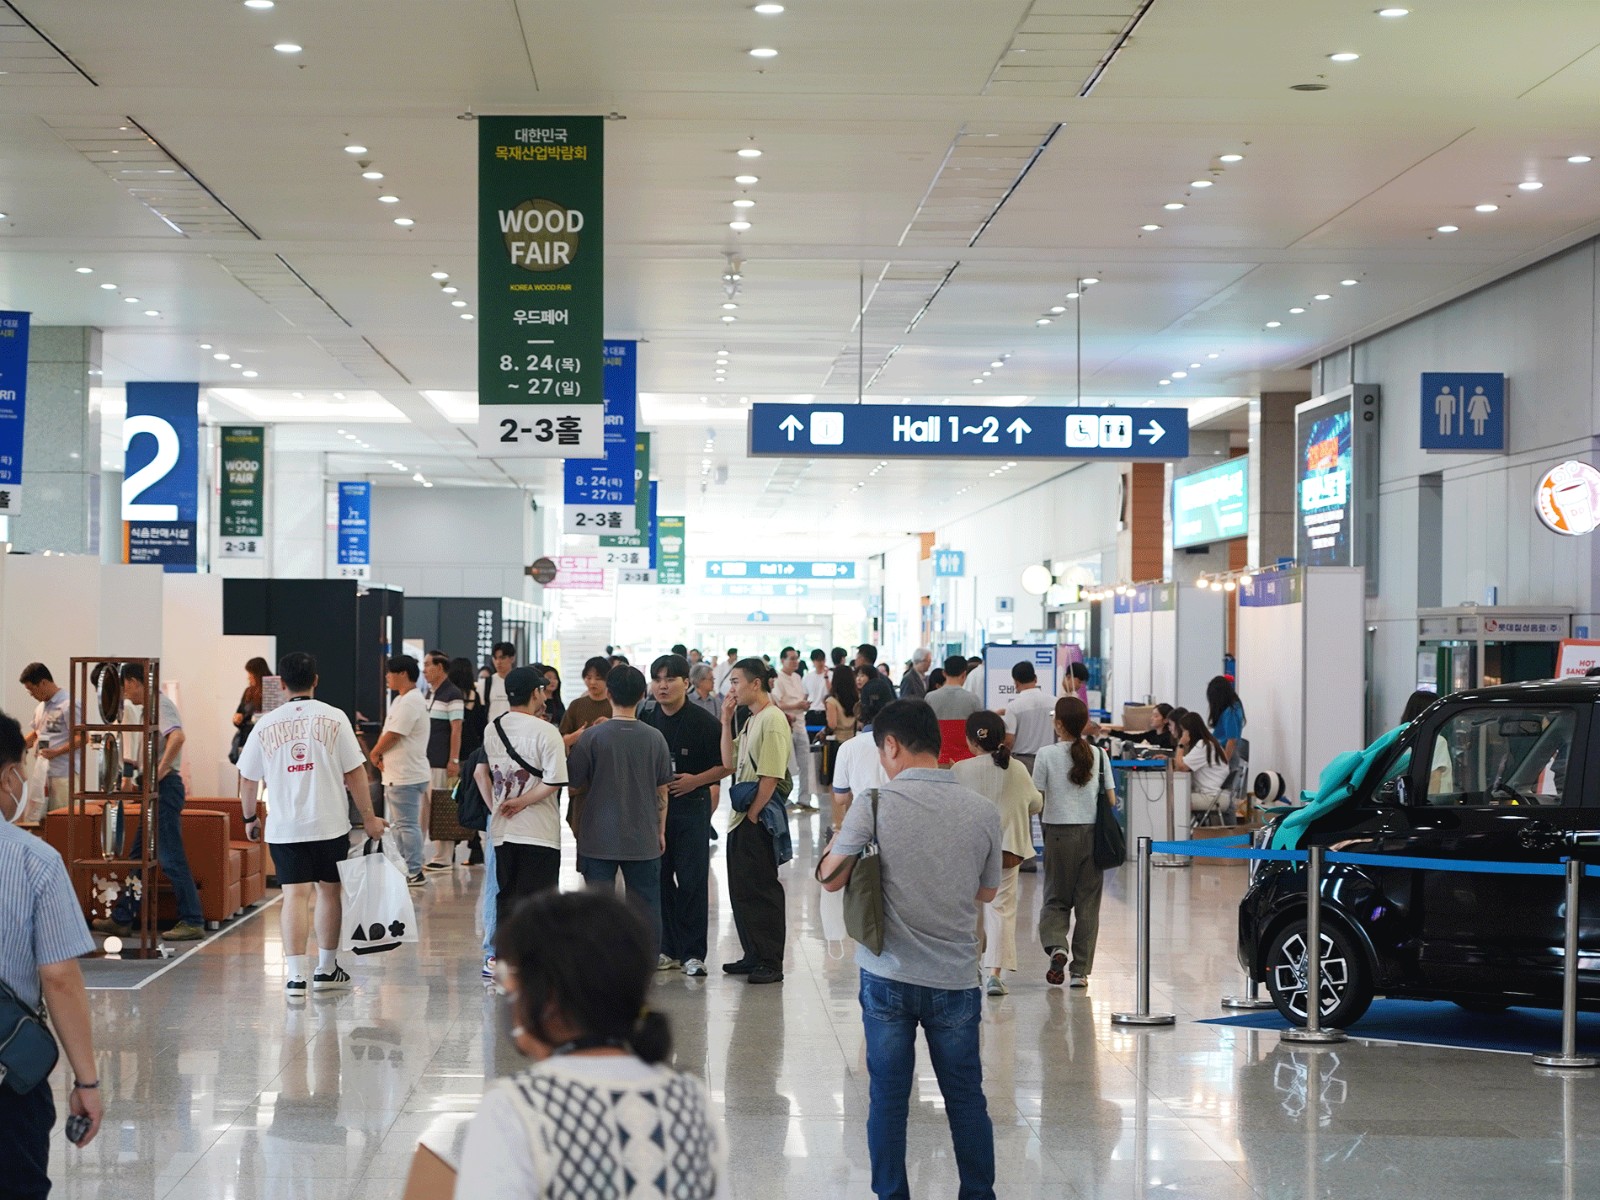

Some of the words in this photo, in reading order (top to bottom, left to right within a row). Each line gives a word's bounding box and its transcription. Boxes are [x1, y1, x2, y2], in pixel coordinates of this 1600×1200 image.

[515, 128, 568, 143] 대한민국
[495, 145, 587, 161] 목재산업박람회
[498, 209, 585, 233] WOOD
[511, 241, 570, 265] FAIR
[510, 283, 533, 291] KOREA
[534, 283, 556, 291] WOOD
[557, 283, 572, 291] FAIR
[513, 309, 568, 325] 우드페어
[499, 354, 519, 371] 8.
[526, 354, 581, 374] 24(목)
[500, 415, 582, 446] 2-3홀
[893, 415, 940, 443] Hall
[948, 415, 999, 443] 1~2
[122, 414, 180, 521] 2
[225, 460, 259, 471] WOOD
[229, 472, 254, 483] FAIR
[575, 475, 588, 486] 8.
[575, 511, 622, 528] 2-3홀
[225, 541, 256, 552] 2-3홀
[607, 552, 639, 564] 2-3홀
[998, 685, 1020, 694] 모바
[258, 718, 310, 759] KANSAS
[311, 716, 341, 755] CITY
[287, 762, 314, 773] CHIEFS
